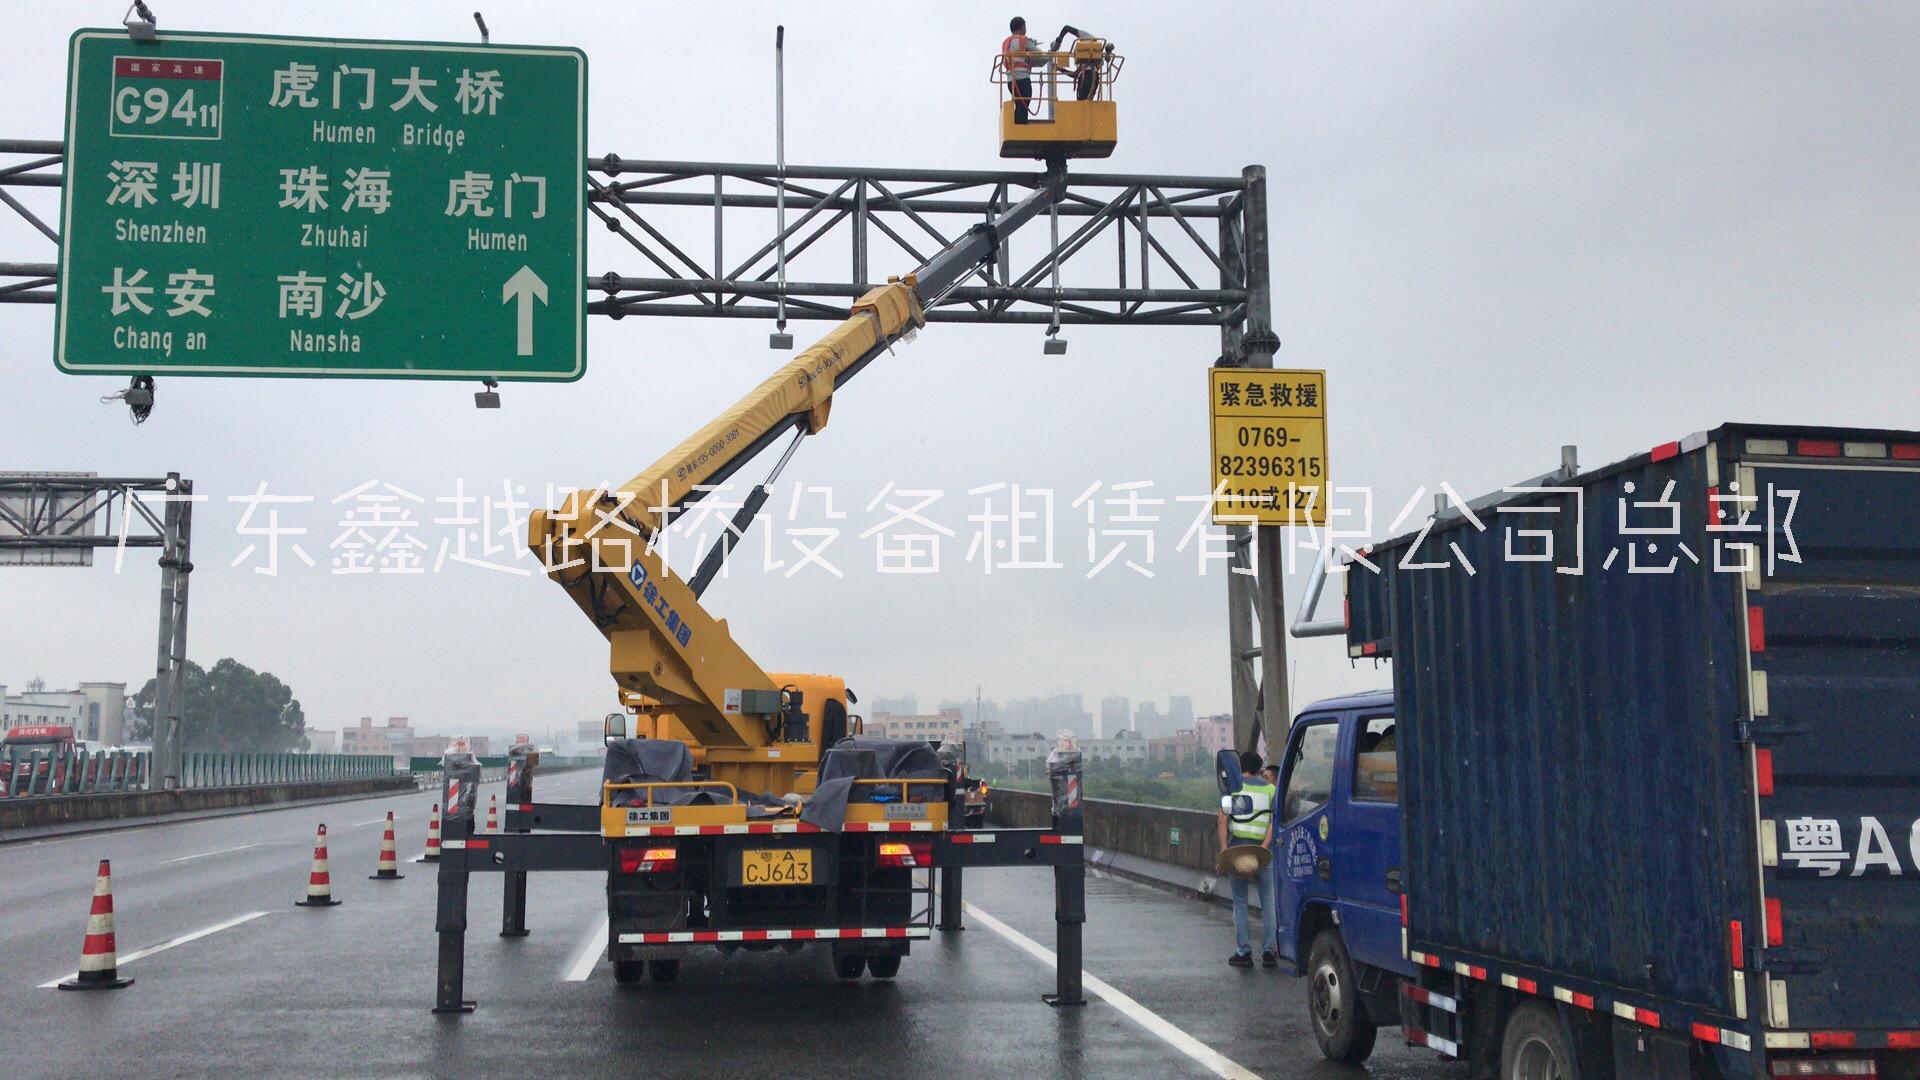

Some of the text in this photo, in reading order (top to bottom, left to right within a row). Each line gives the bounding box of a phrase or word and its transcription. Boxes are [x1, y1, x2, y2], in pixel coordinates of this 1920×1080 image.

[130, 63, 204, 75] 国家高速
[269, 62, 504, 116] 虎门大桥
[313, 121, 465, 154] Humen Bridge
[106, 160, 221, 209] 深圳
[278, 166, 392, 214] 珠海
[444, 171, 547, 219] 虎门
[115, 219, 206, 244] Shenzhen
[301, 224, 368, 248] Zhuhai
[468, 229, 527, 251] Humen
[101, 267, 216, 317] 长安
[277, 271, 387, 320] 南沙
[114, 327, 207, 358] Chang an
[290, 330, 361, 353] Nansha
[1220, 382, 1318, 408] 紧急救援
[1238, 426, 1301, 448] 0769-
[1220, 456, 1321, 478] 82396315
[643, 580, 692, 648] 徐工集团
[629, 811, 670, 821] 徐工集团
[1782, 816, 1920, 877] 粤A
[746, 863, 808, 882] CJ643
